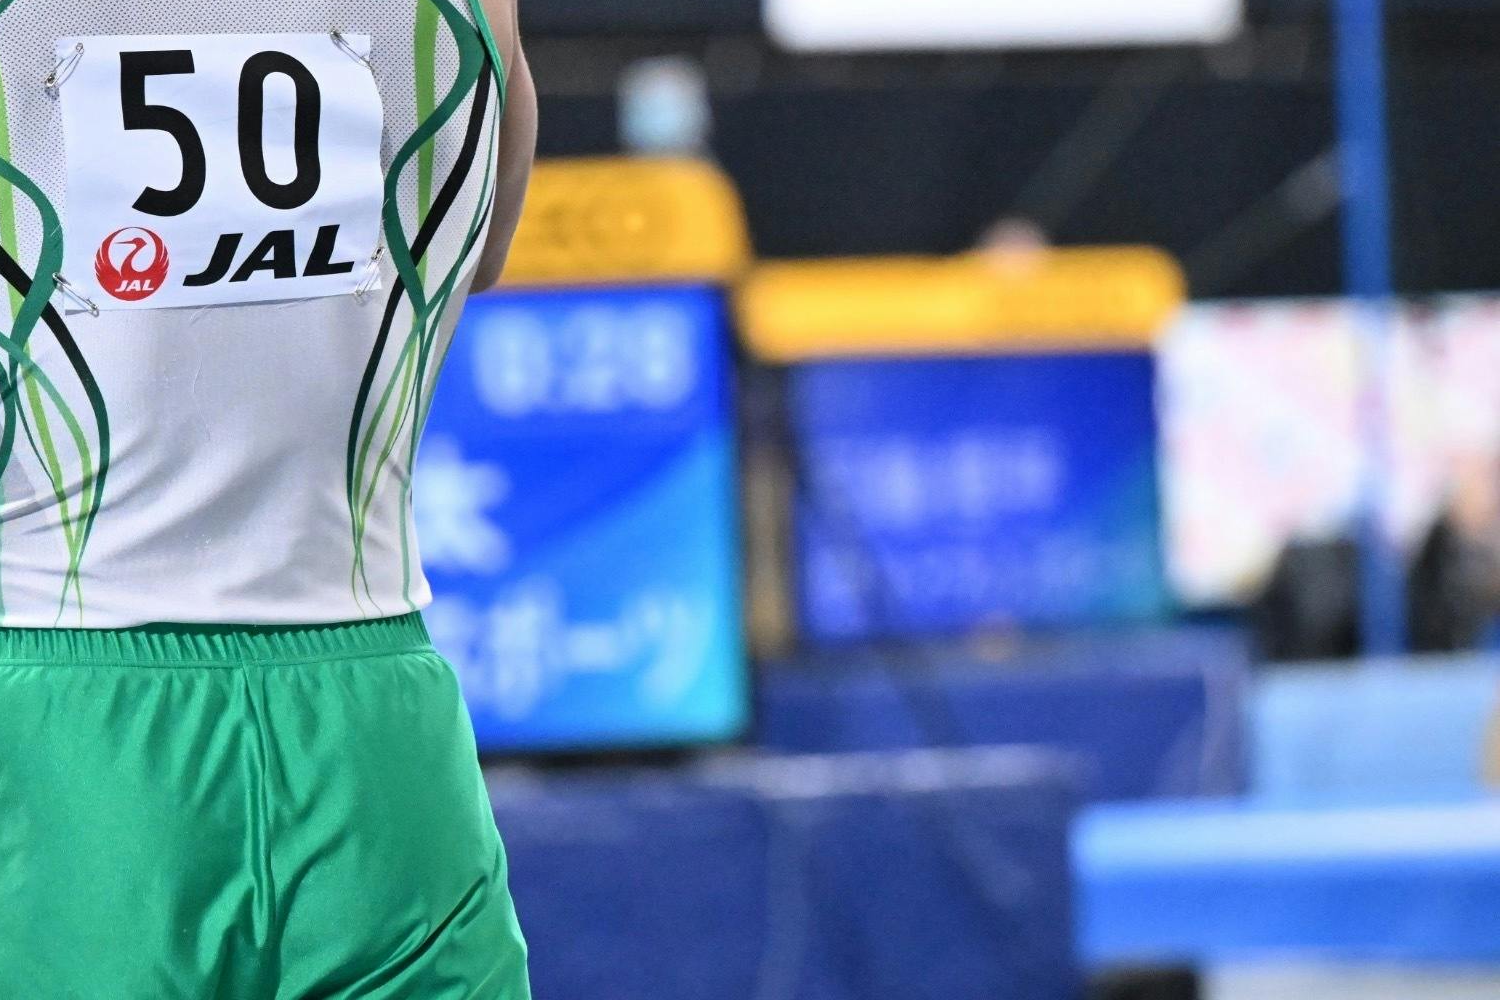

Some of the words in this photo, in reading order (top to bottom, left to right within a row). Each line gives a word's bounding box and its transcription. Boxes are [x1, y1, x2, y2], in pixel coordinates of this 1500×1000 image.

[119, 49, 321, 217] 50
[114, 279, 155, 293] JAL
[182, 224, 355, 287] JAL
